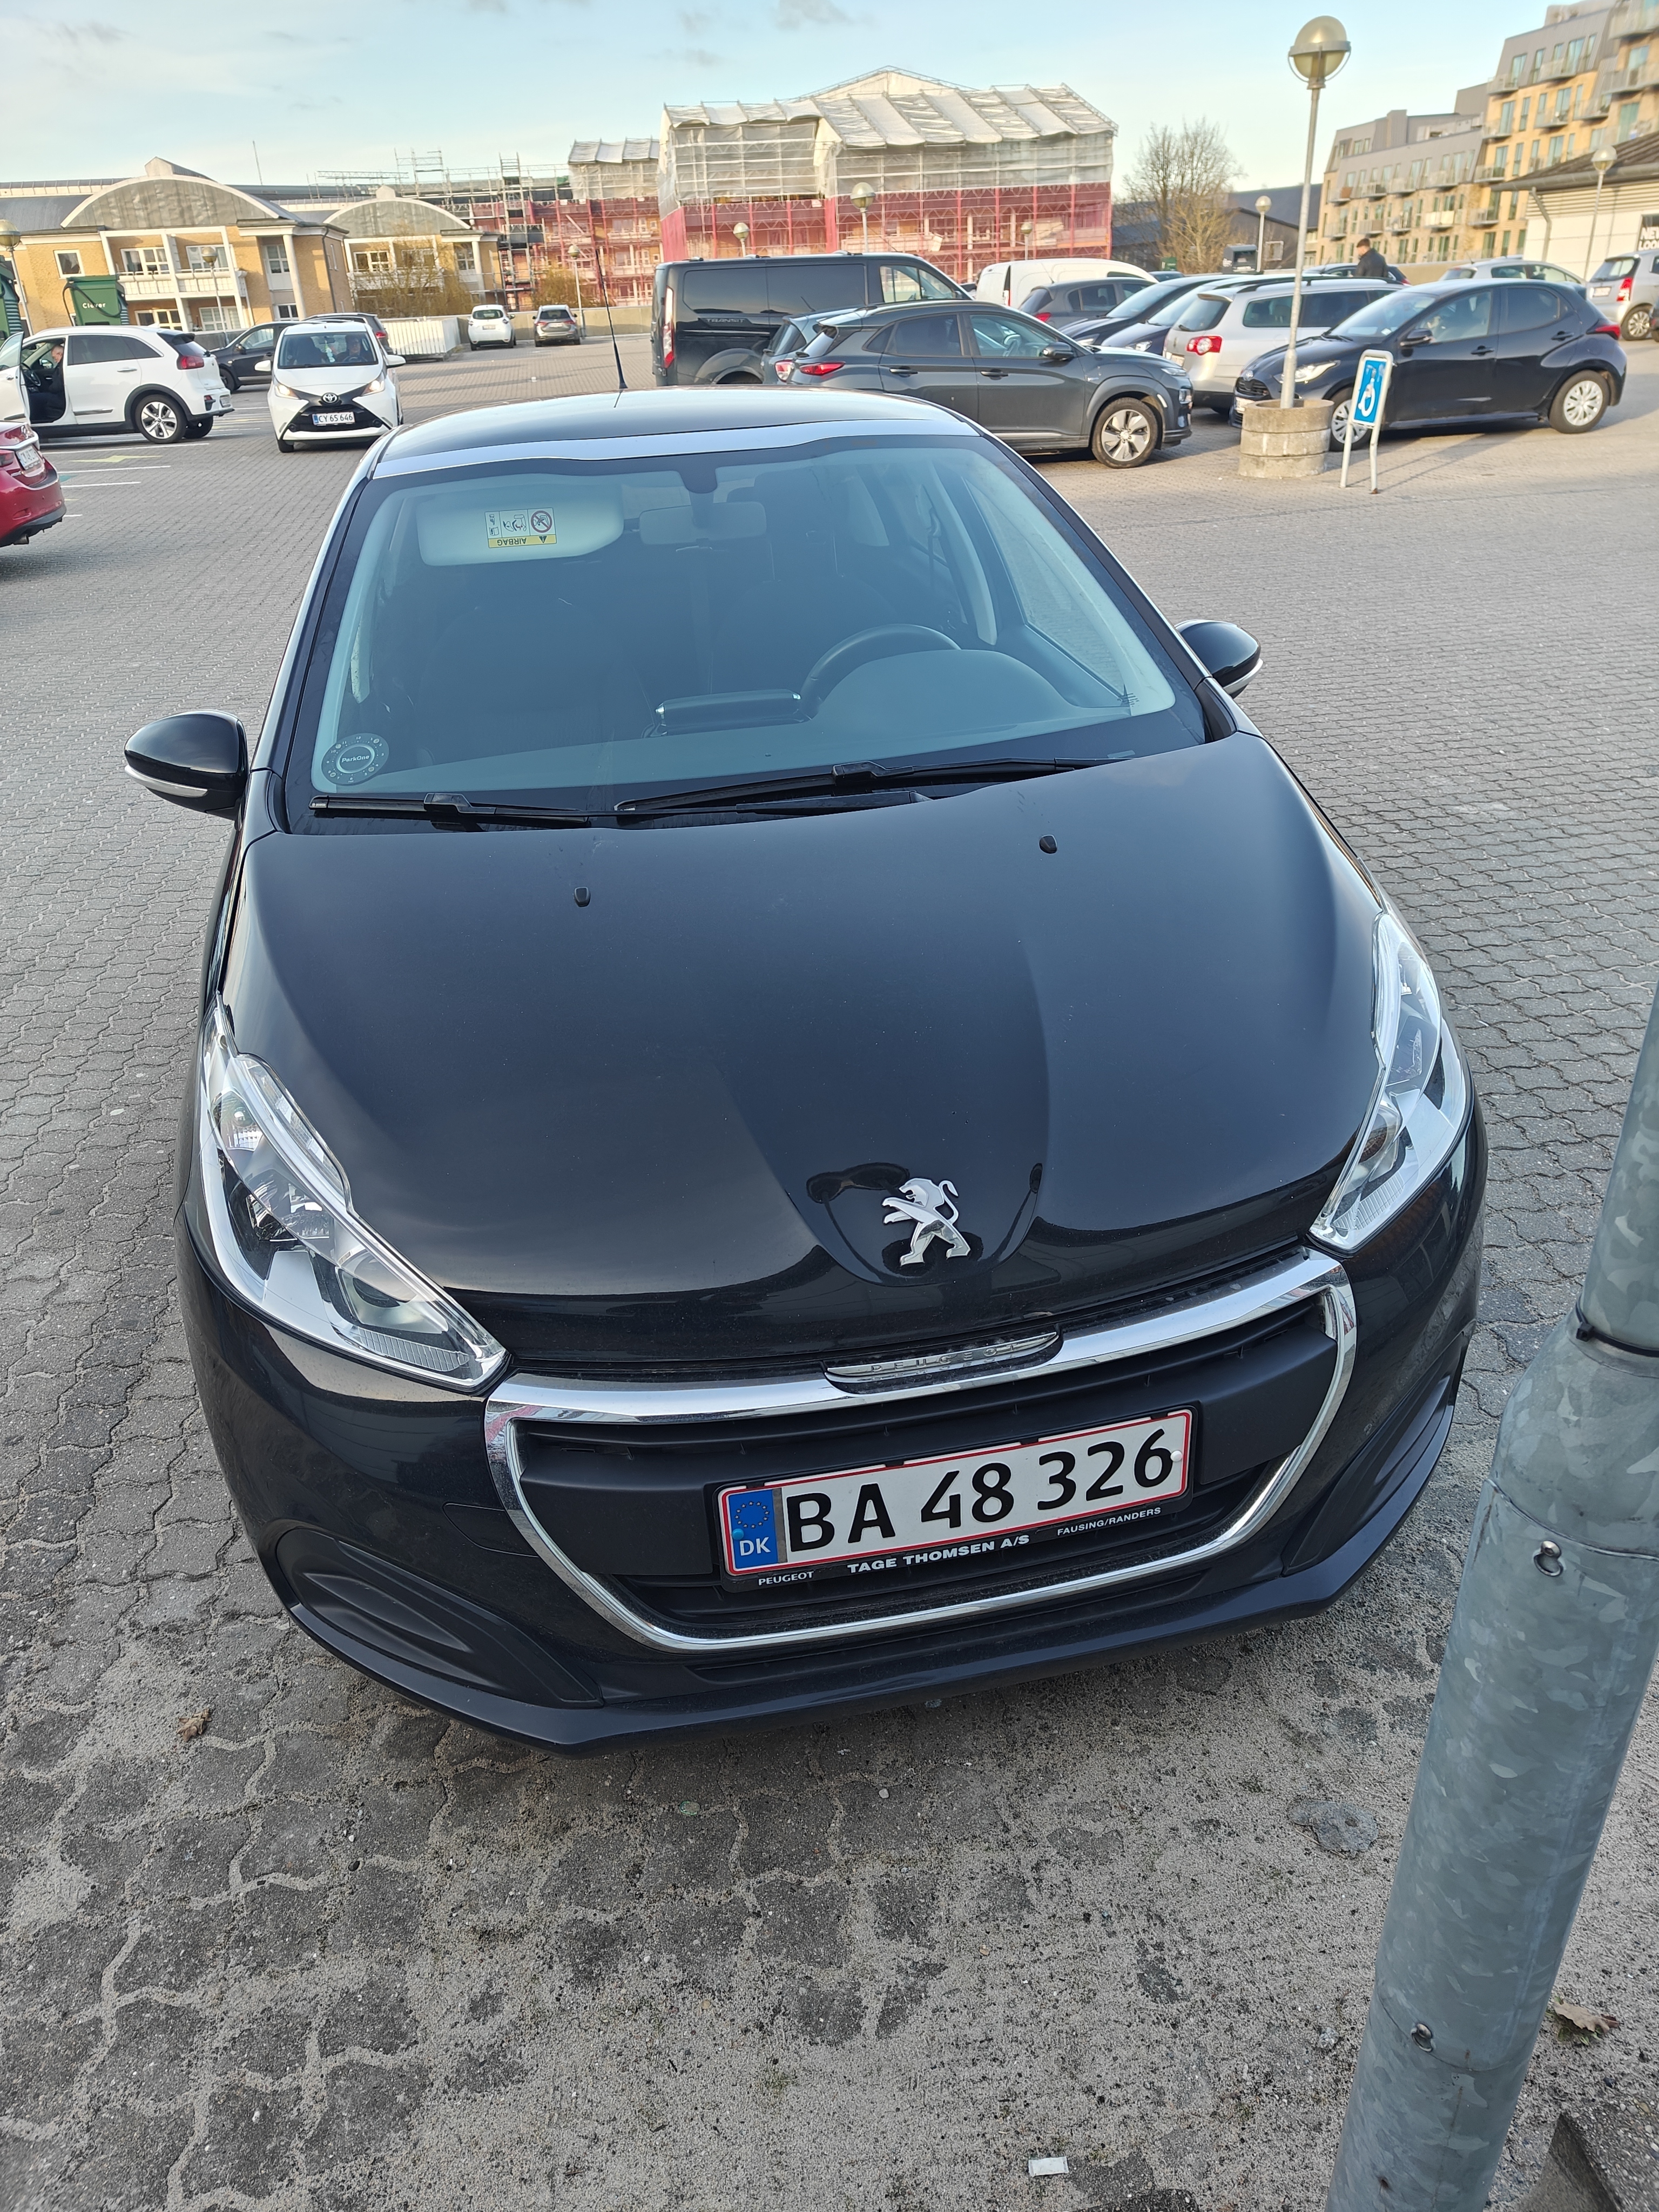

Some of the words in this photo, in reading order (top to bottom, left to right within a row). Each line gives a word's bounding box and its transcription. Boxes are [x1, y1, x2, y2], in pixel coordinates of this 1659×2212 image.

[1638, 240, 1659, 251] LOO
[497, 537, 527, 546] AIRBAG
[786, 1483, 896, 1552] BA
[921, 1462, 1014, 1529] 48
[1037, 1428, 1174, 1510] 326
[1057, 1507, 1161, 1536] FAUSING/RANDERS
[739, 1537, 771, 1556] DK
[847, 1558, 897, 1573] TAGE
[902, 1541, 995, 1565] THOMSEN
[1001, 1534, 1030, 1548] A/S
[758, 1571, 814, 1586] PEUGEOT
